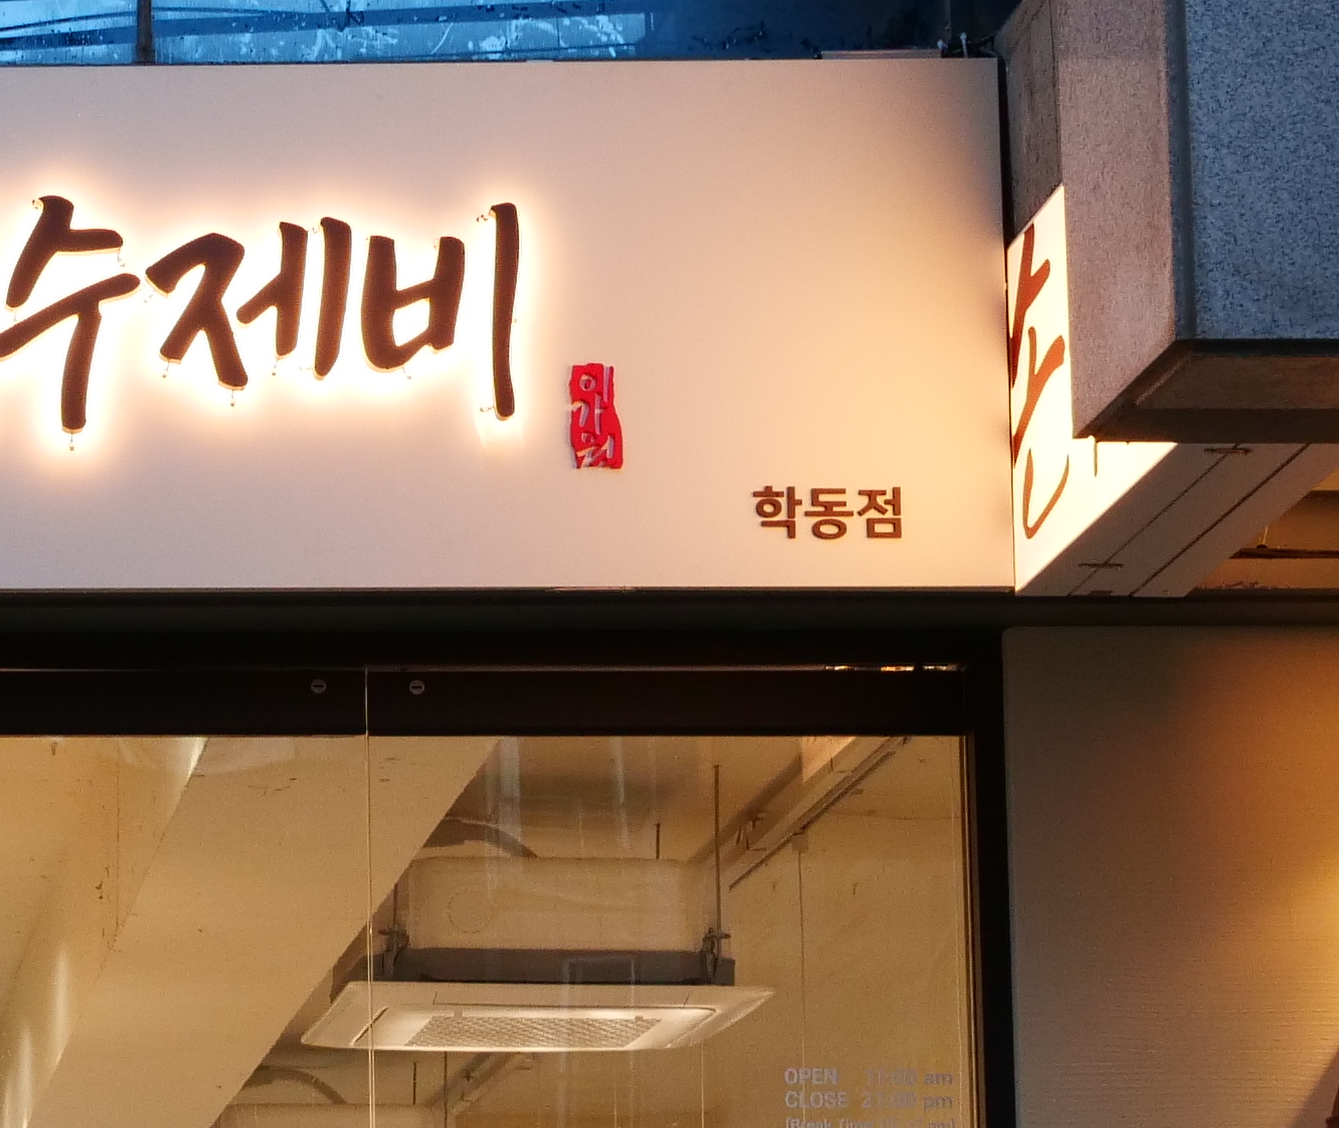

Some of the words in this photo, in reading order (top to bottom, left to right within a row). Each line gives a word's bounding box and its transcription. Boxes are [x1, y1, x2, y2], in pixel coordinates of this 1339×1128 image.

[752, 485, 903, 539] 학동점
[784, 1068, 839, 1085] OPEN
[784, 1091, 848, 1108] CLOSE
